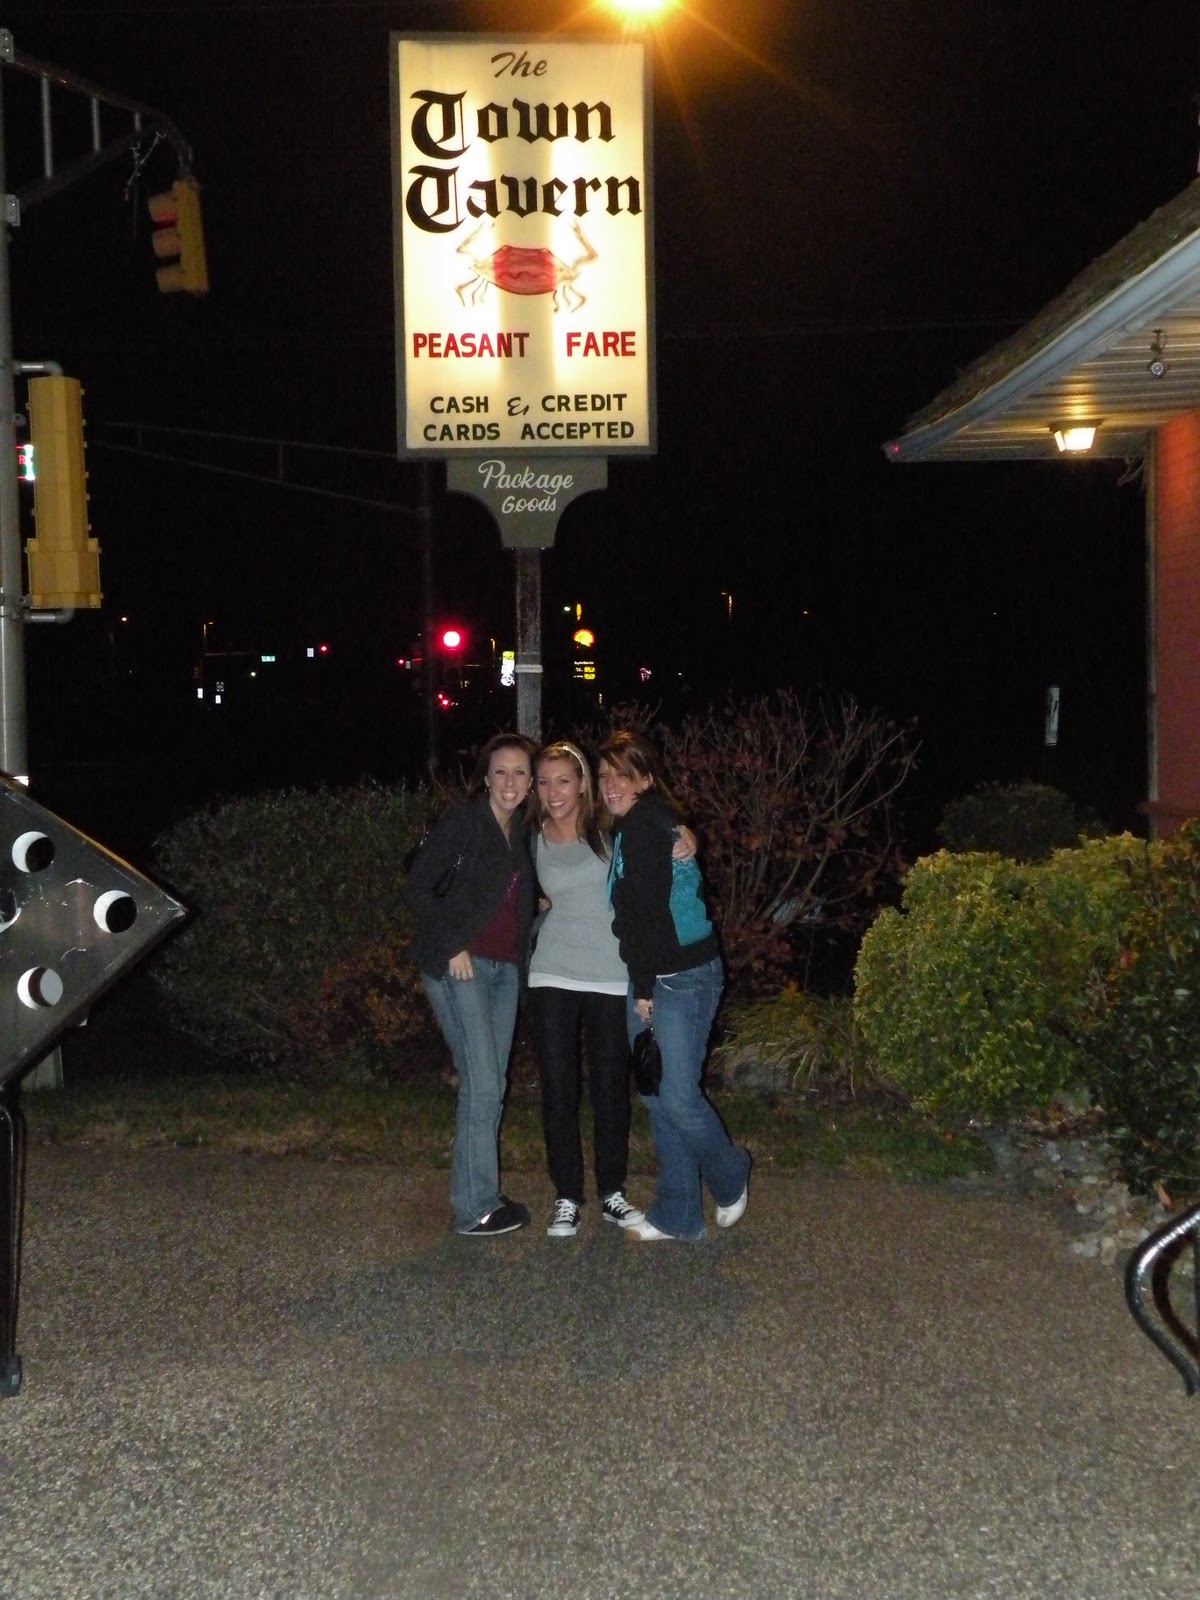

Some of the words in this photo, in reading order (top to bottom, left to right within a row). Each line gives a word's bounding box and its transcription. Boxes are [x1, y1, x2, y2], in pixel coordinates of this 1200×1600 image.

[491, 50, 548, 78] The
[410, 89, 616, 160] Town
[405, 164, 643, 234] Tavern
[413, 332, 530, 358] PEASANT
[566, 331, 637, 357] FARE
[429, 396, 489, 414] CASH
[507, 396, 530, 417] &
[541, 393, 627, 413] CREDIT
[423, 423, 501, 442] CARDS
[520, 421, 635, 440] ACCEPTED
[477, 459, 574, 495] Package
[501, 494, 557, 515] Goods
